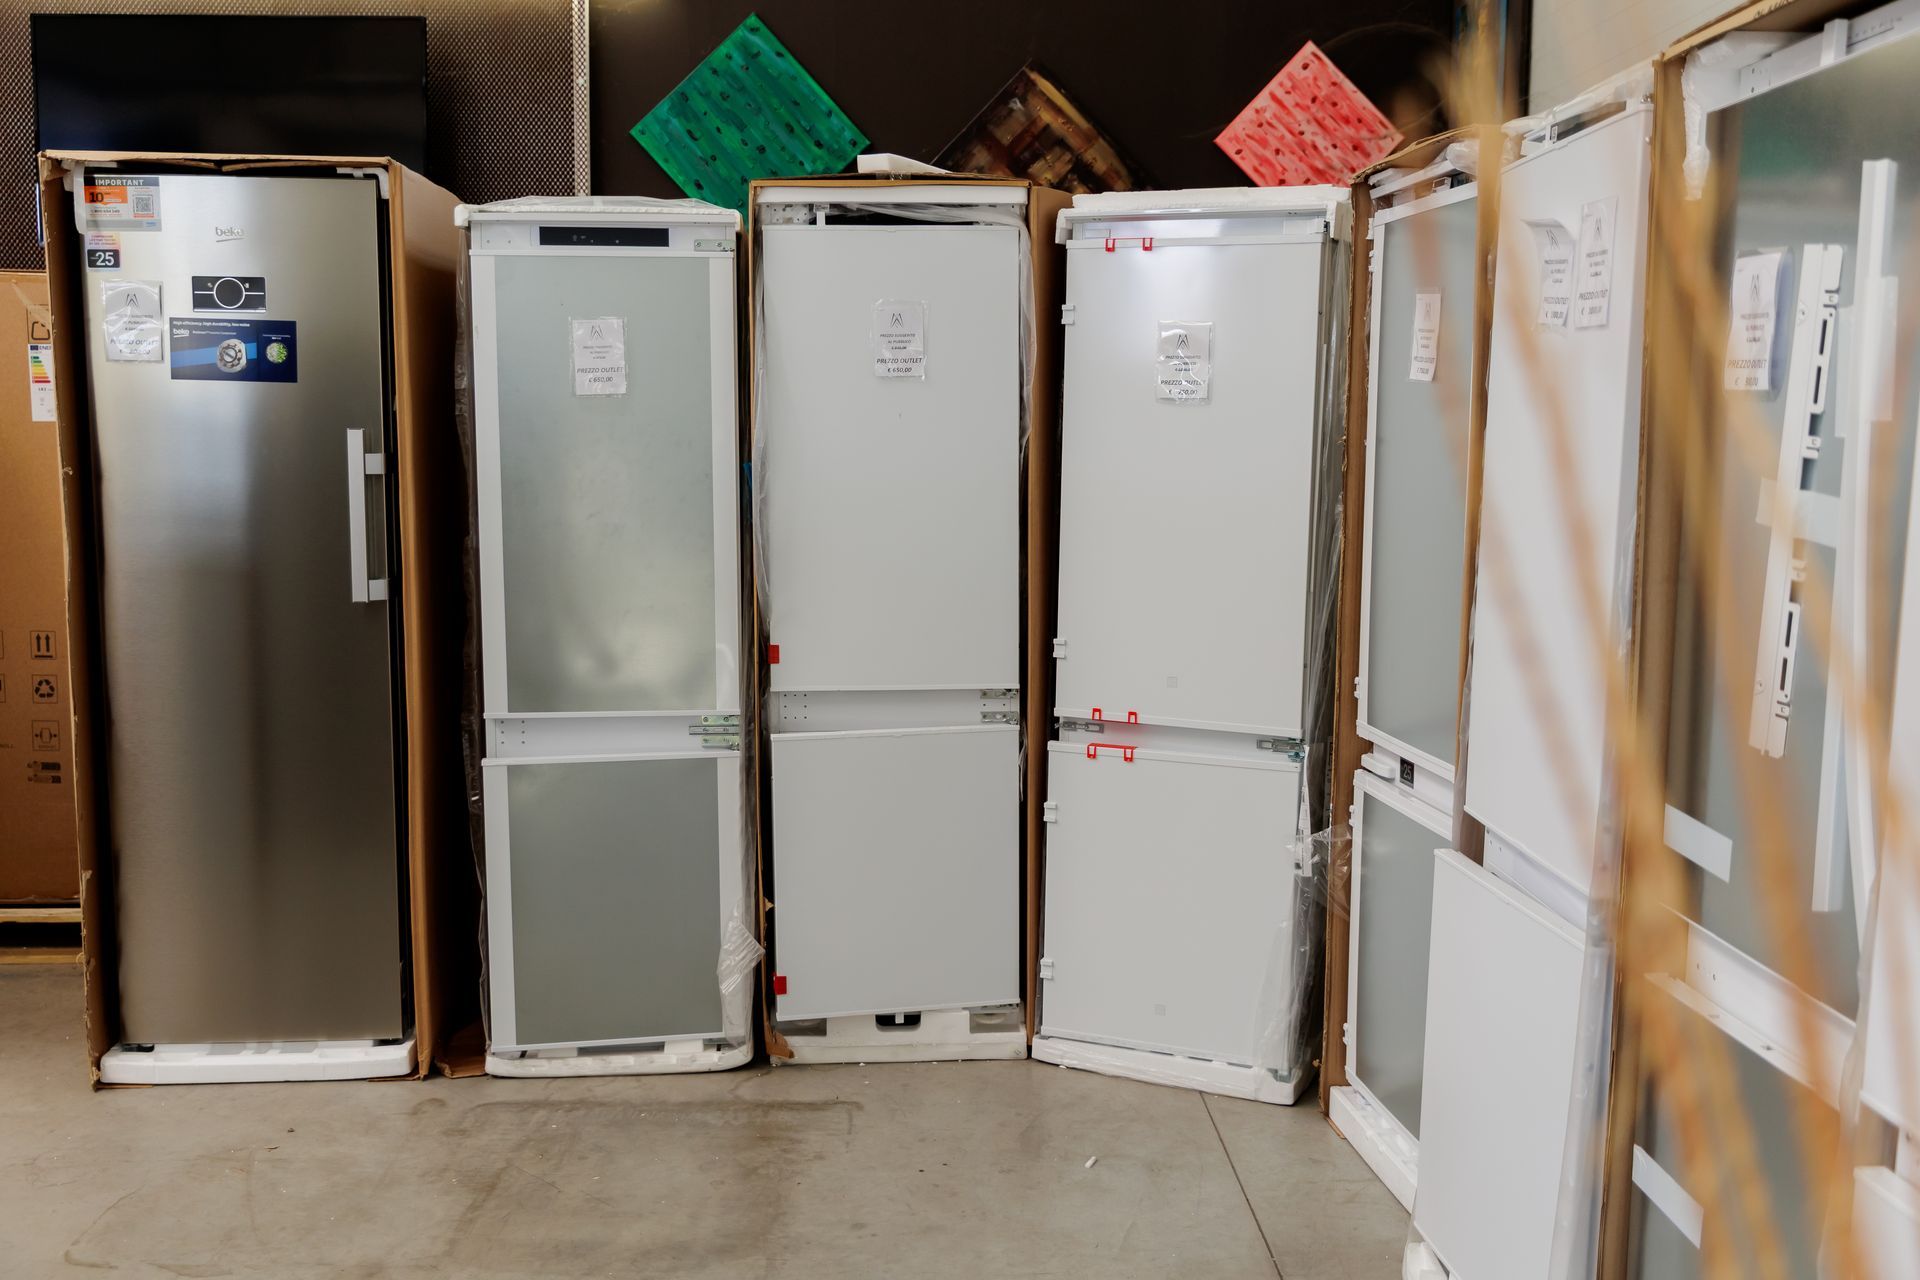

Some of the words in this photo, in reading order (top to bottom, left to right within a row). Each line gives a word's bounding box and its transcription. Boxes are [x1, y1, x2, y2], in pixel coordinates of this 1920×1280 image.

[89, 192, 104, 203] 10
[95, 251, 115, 266] 25
[1403, 763, 1412, 781] 25
